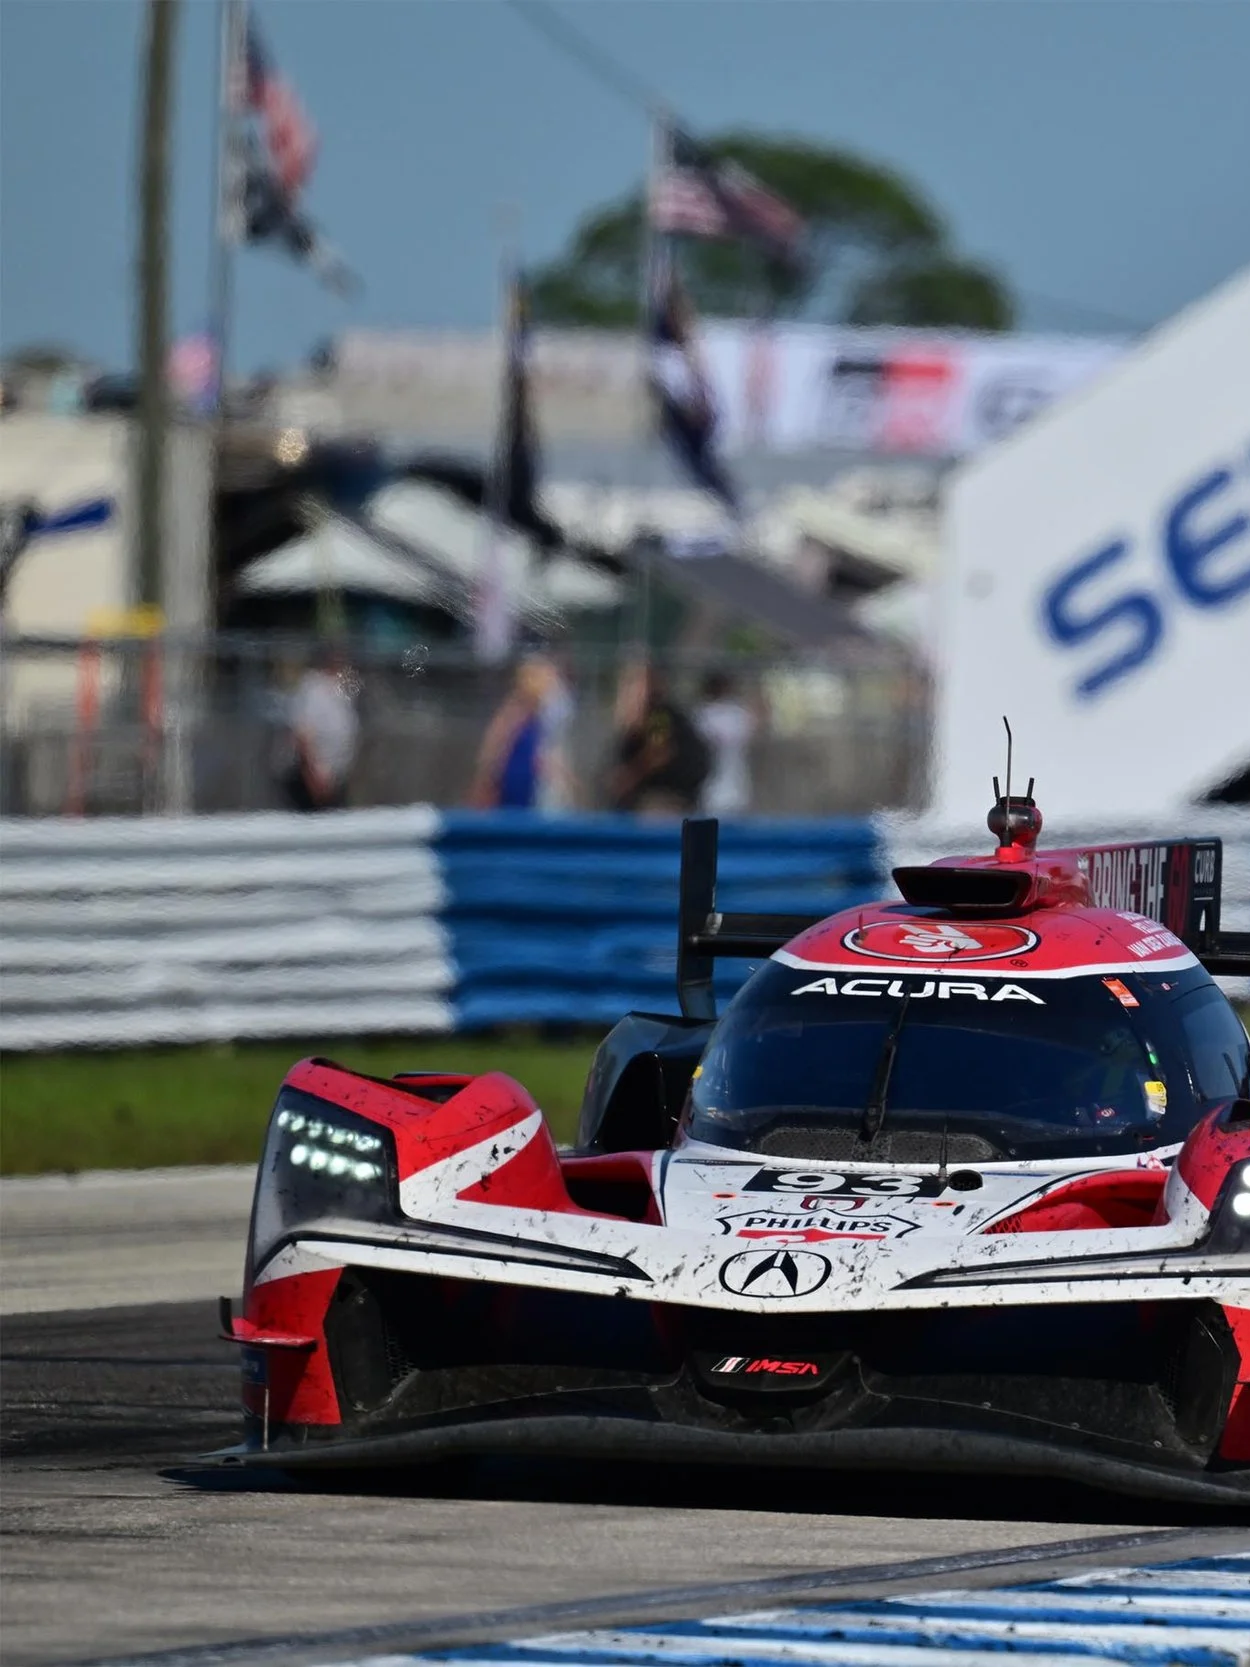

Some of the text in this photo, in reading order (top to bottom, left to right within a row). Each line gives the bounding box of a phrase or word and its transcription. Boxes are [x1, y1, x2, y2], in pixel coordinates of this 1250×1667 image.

[1195, 850, 1215, 883] CURB
[1140, 847, 1167, 927] THE
[791, 977, 1047, 1005] ACURA
[772, 1172, 923, 1196] 93
[745, 1217, 892, 1232] PHILLIPS
[745, 1359, 818, 1375] IMSA
